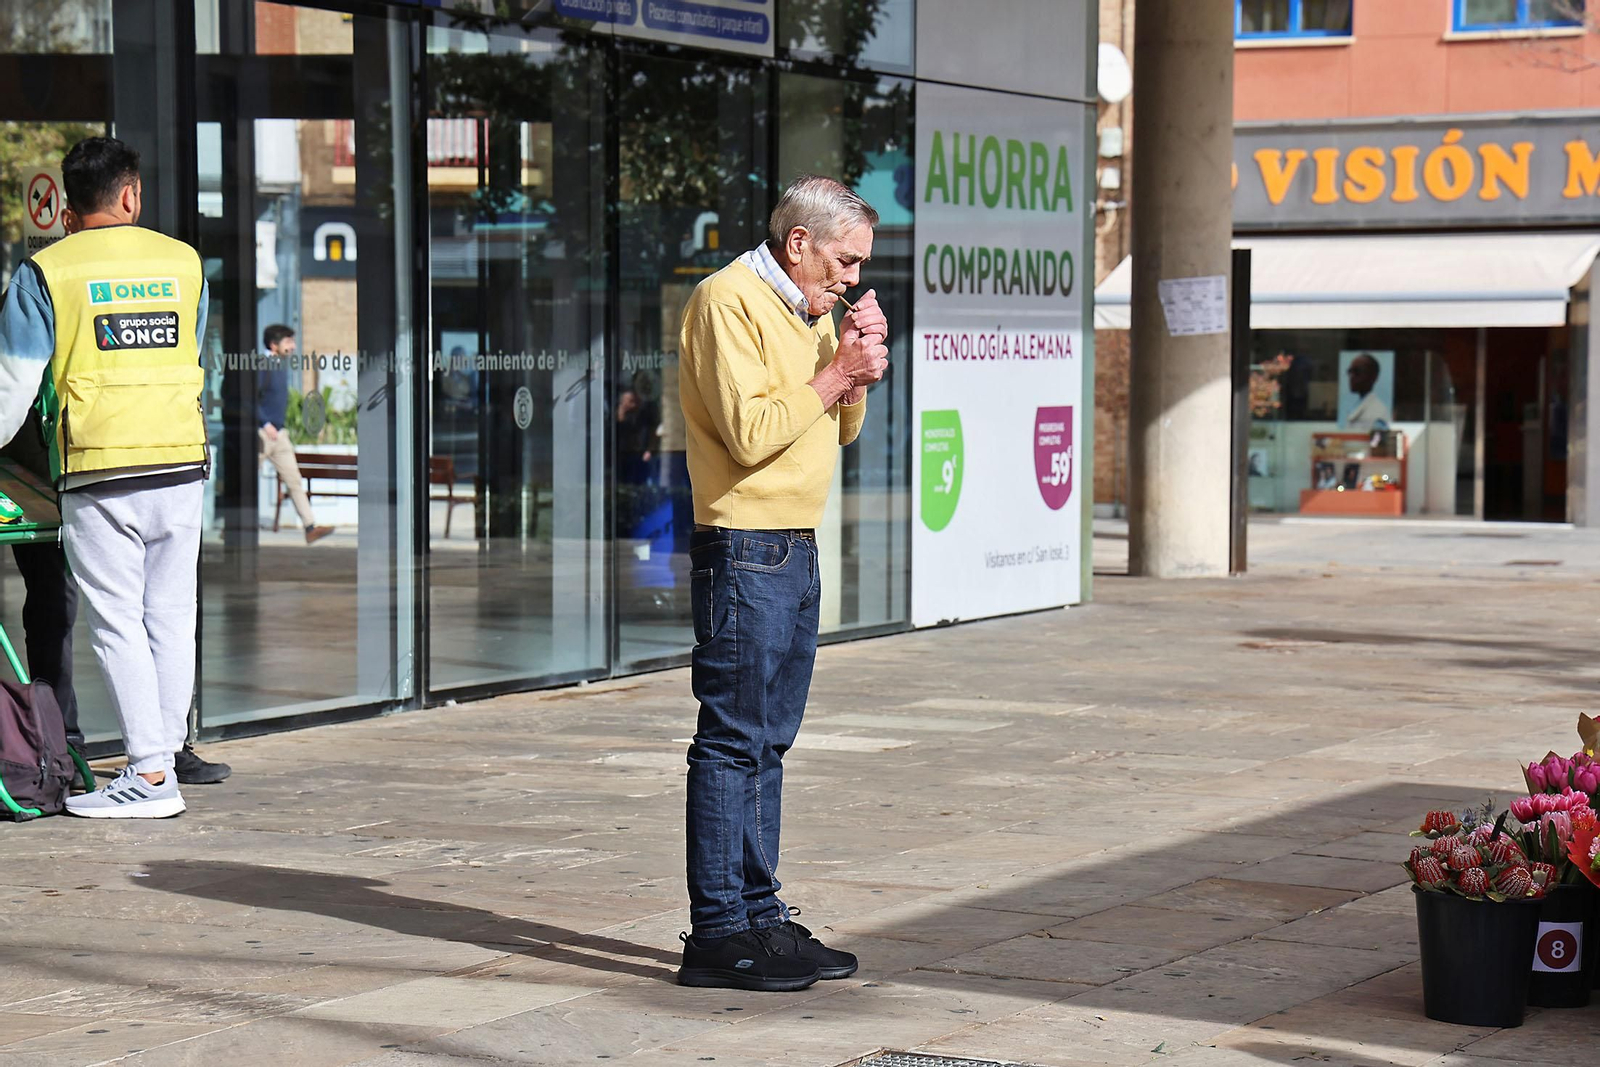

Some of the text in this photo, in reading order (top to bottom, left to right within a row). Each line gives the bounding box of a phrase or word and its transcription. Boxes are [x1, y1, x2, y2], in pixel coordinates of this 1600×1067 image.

[606, 1, 631, 17] pvada
[648, 2, 676, 23] Piscinas
[677, 10, 716, 29] comunitarias
[722, 17, 743, 35] parque
[743, 17, 764, 35] infantil
[924, 130, 1073, 213] AHORRA
[1254, 128, 1535, 206] VISIÓN
[923, 243, 1074, 298] COMPRANDO
[115, 282, 173, 299] ONCE
[119, 315, 176, 329] grupo social
[121, 327, 176, 345] ONCE
[924, 325, 1073, 361] TECNOLOGÍA ALEMANA
[332, 350, 352, 371] de
[433, 349, 535, 377] Ayuntamiento
[538, 350, 555, 371] de
[1035, 545, 1048, 562] San
[1551, 940, 1565, 959] 8
